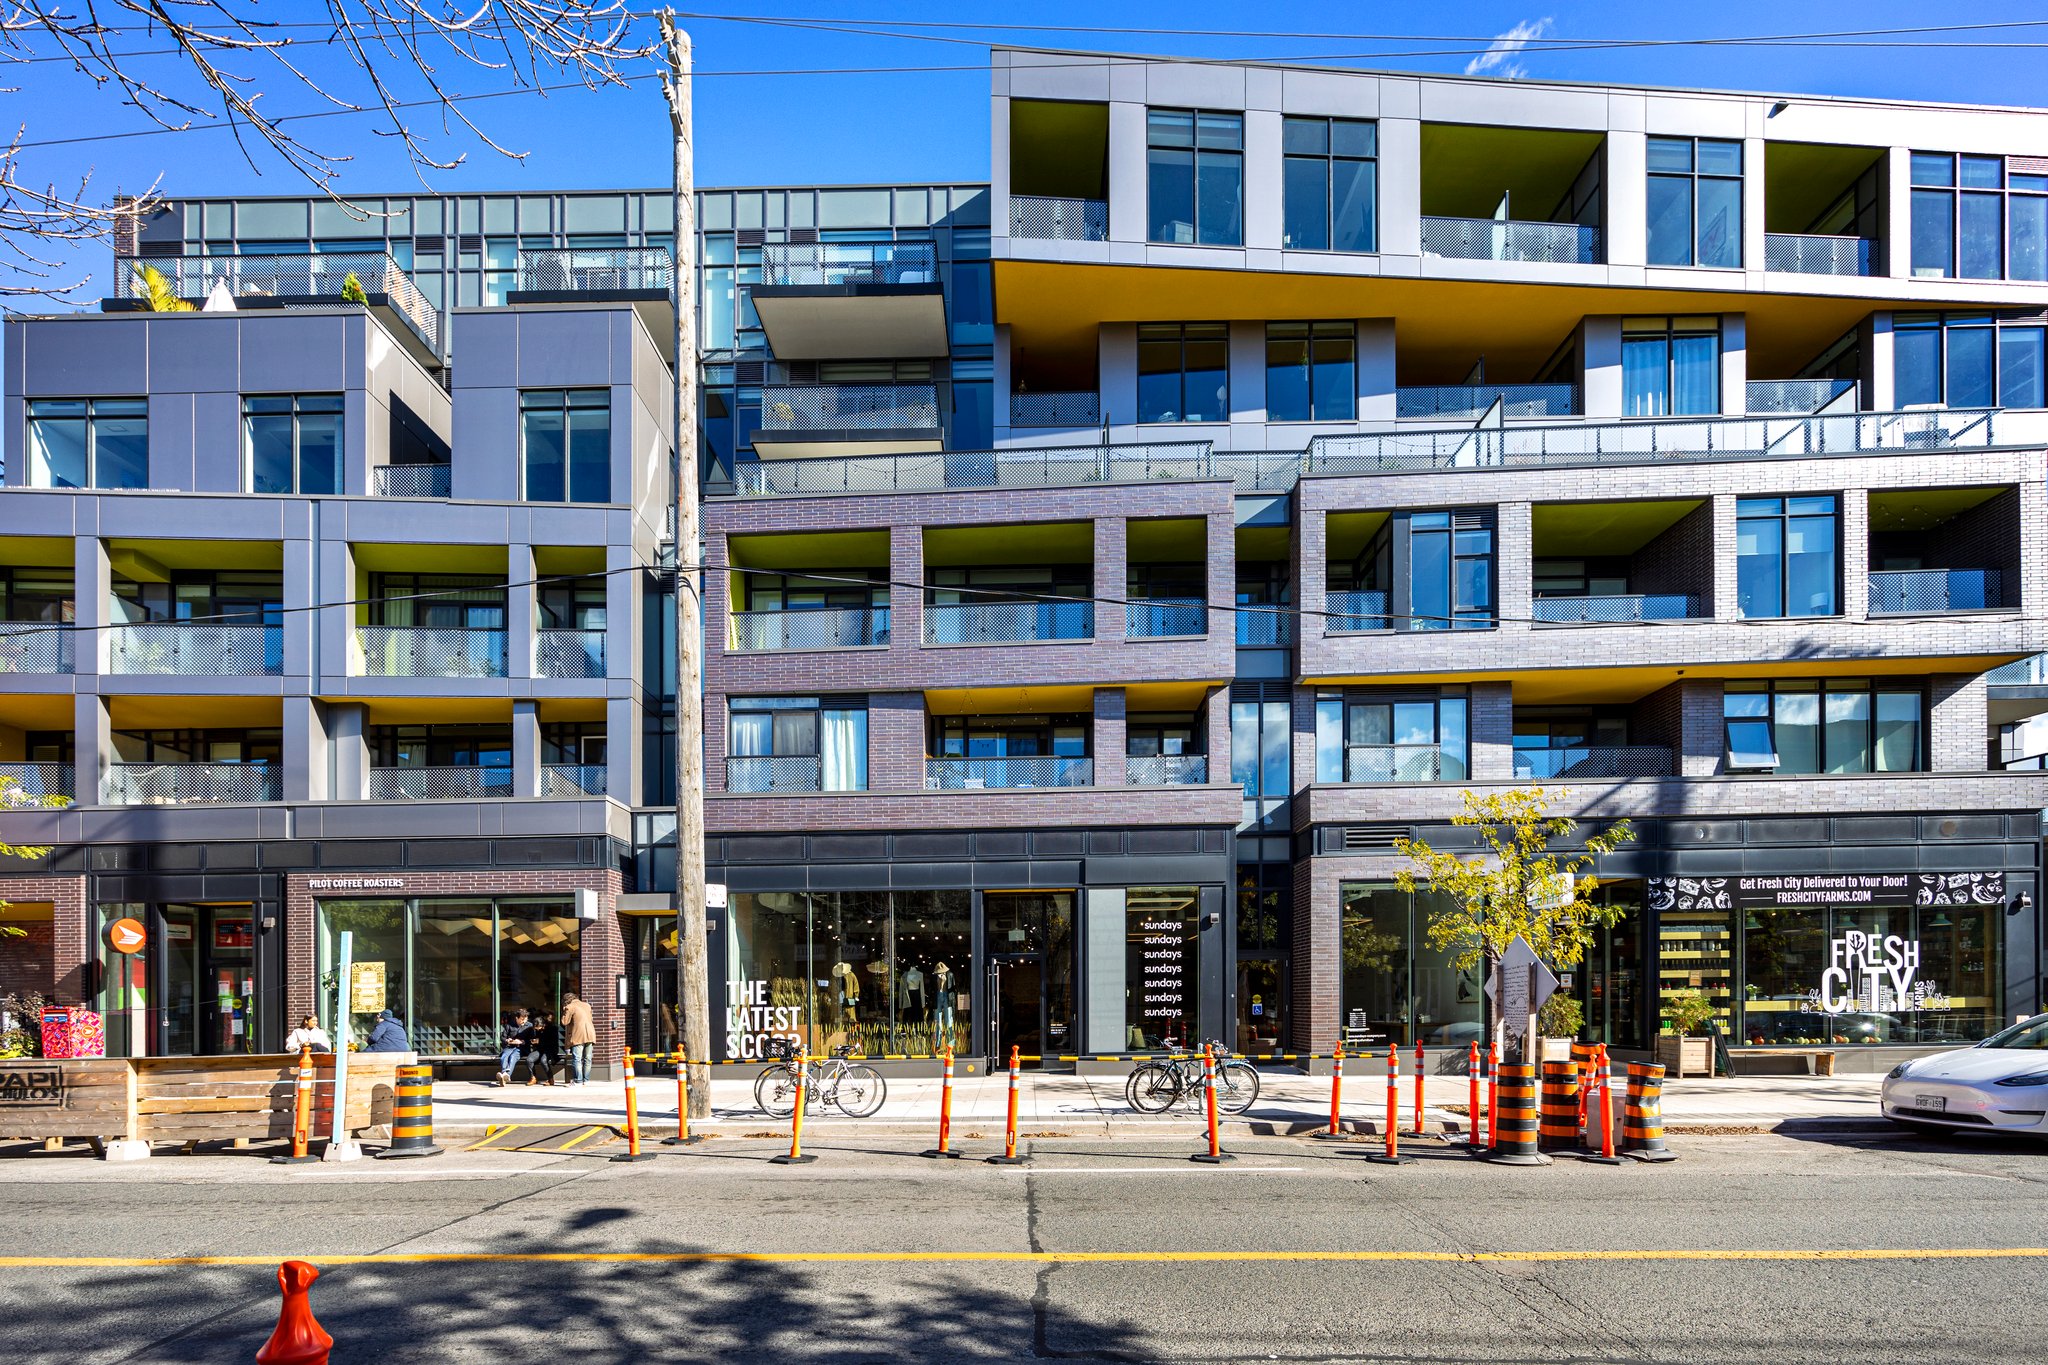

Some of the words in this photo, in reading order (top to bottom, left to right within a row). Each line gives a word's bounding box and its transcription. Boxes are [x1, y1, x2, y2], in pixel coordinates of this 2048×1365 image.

[309, 880, 331, 888] PILOT
[333, 879, 362, 888] COFFEE
[363, 879, 404, 887] ROASTERS
[1740, 878, 1755, 889] Get
[1757, 877, 1782, 889] Fresh
[1784, 876, 1802, 890] City
[1803, 876, 1846, 888] Delivered
[1849, 876, 1857, 887] to
[1859, 876, 1880, 887] Your
[1882, 875, 1908, 887] Door!
[1777, 891, 1871, 903] FRESHCITYFARMS.COM
[1144, 920, 1182, 932] sundays
[1144, 935, 1182, 946] sundays
[1144, 949, 1182, 960] sundays
[1831, 930, 1919, 970] FRESH
[1144, 964, 1182, 975] sundays
[1144, 978, 1182, 990] sundays
[1822, 966, 1915, 1013] CITY
[726, 980, 767, 1005] THE
[1144, 992, 1182, 1004] sundays
[1914, 981, 1925, 1011] FARMS
[1144, 1007, 1182, 1018] sundays
[726, 1007, 801, 1031] LATEST
[0, 1072, 57, 1087] API
